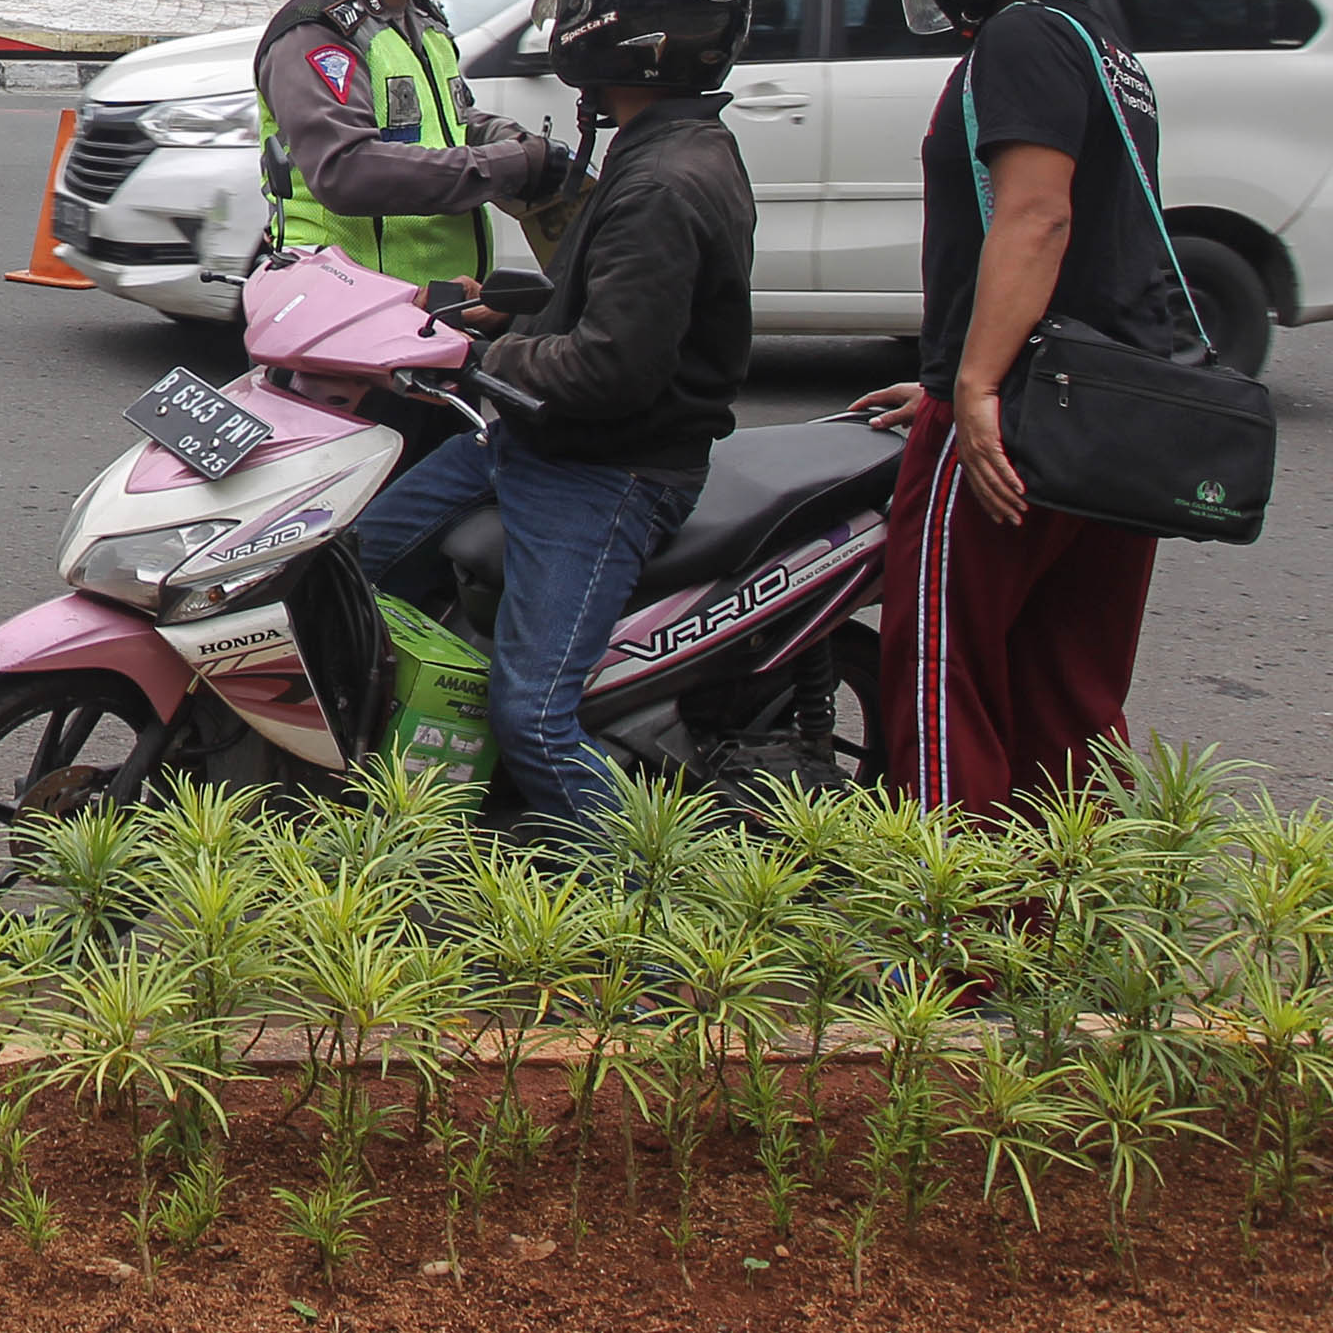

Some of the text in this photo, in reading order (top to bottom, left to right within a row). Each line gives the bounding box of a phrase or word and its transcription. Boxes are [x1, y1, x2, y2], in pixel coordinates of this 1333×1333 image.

[153, 373, 263, 448] B 6345 PNY
[209, 526, 302, 562] VARIO
[617, 566, 788, 659] VARIO
[197, 629, 283, 655] HONDA
[434, 674, 489, 698] AMARO
